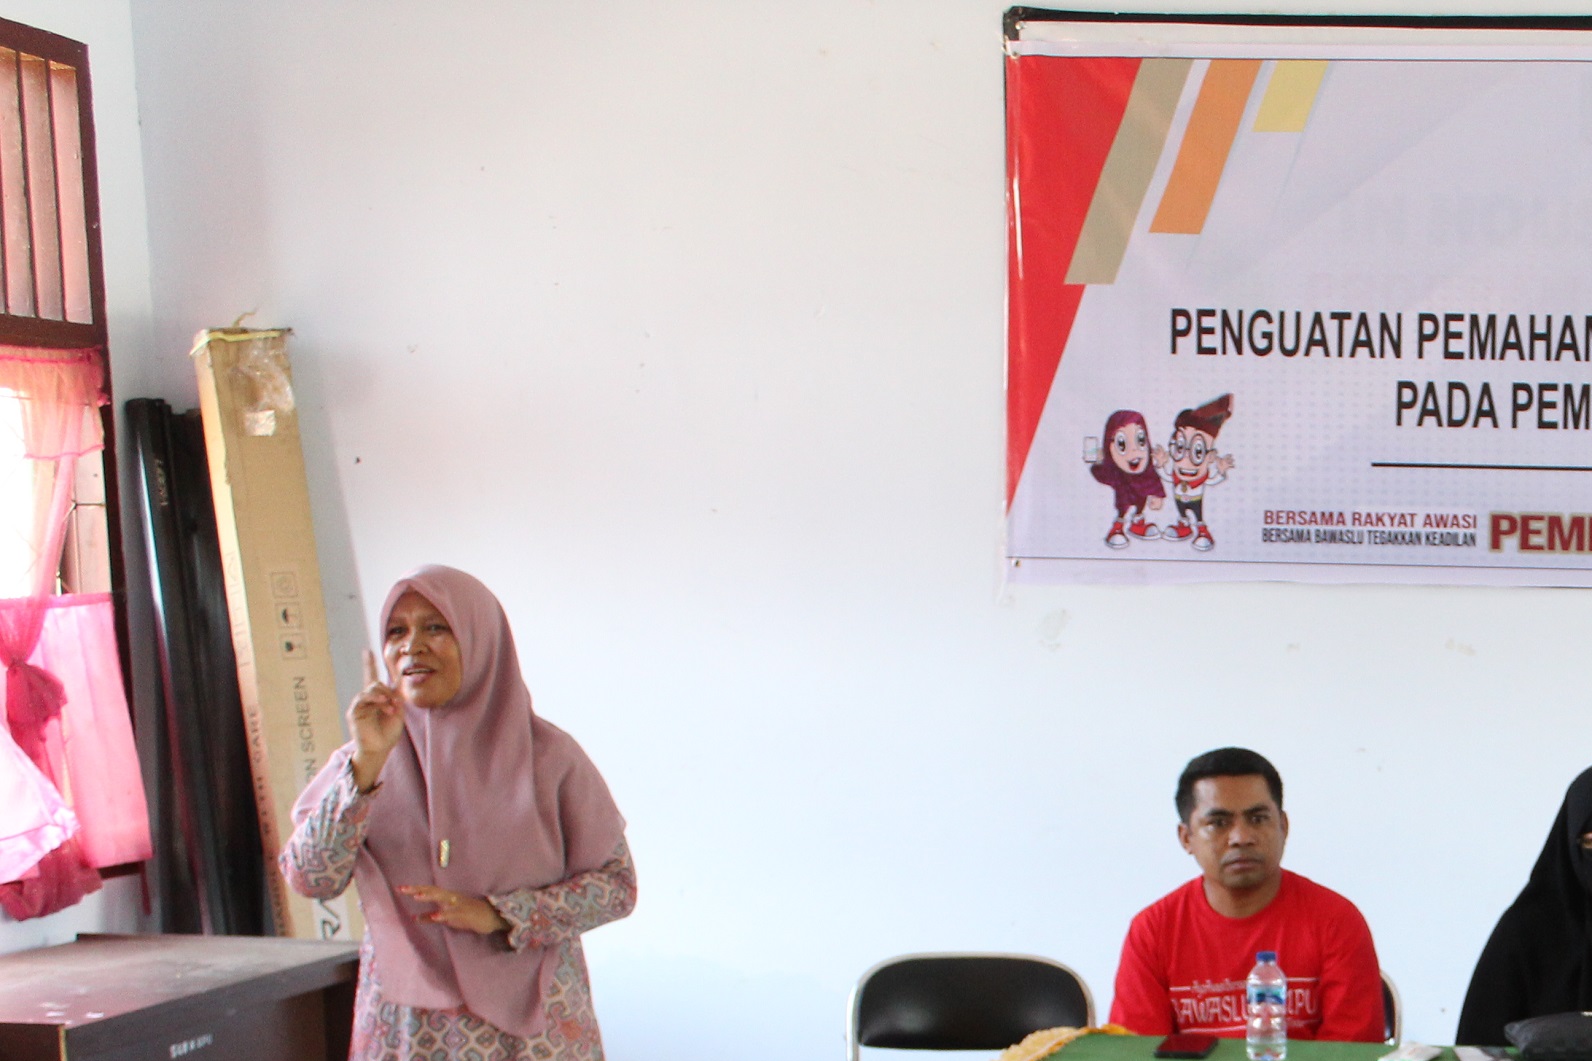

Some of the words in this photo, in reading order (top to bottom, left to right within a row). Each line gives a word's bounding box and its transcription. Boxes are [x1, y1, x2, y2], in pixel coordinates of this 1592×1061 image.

[1170, 308, 1403, 360] PENGUATAN
[1395, 380, 1500, 429] PADA
[1262, 527, 1312, 543] BERSAMA
[1314, 528, 1364, 544] BAWASLU
[1424, 531, 1477, 547] KEADILAN
[1263, 509, 1347, 526] BERSAMA
[1351, 511, 1418, 527] RAKYAT
[1422, 513, 1478, 529] AWASI
[293, 675, 315, 753] SCREEN
